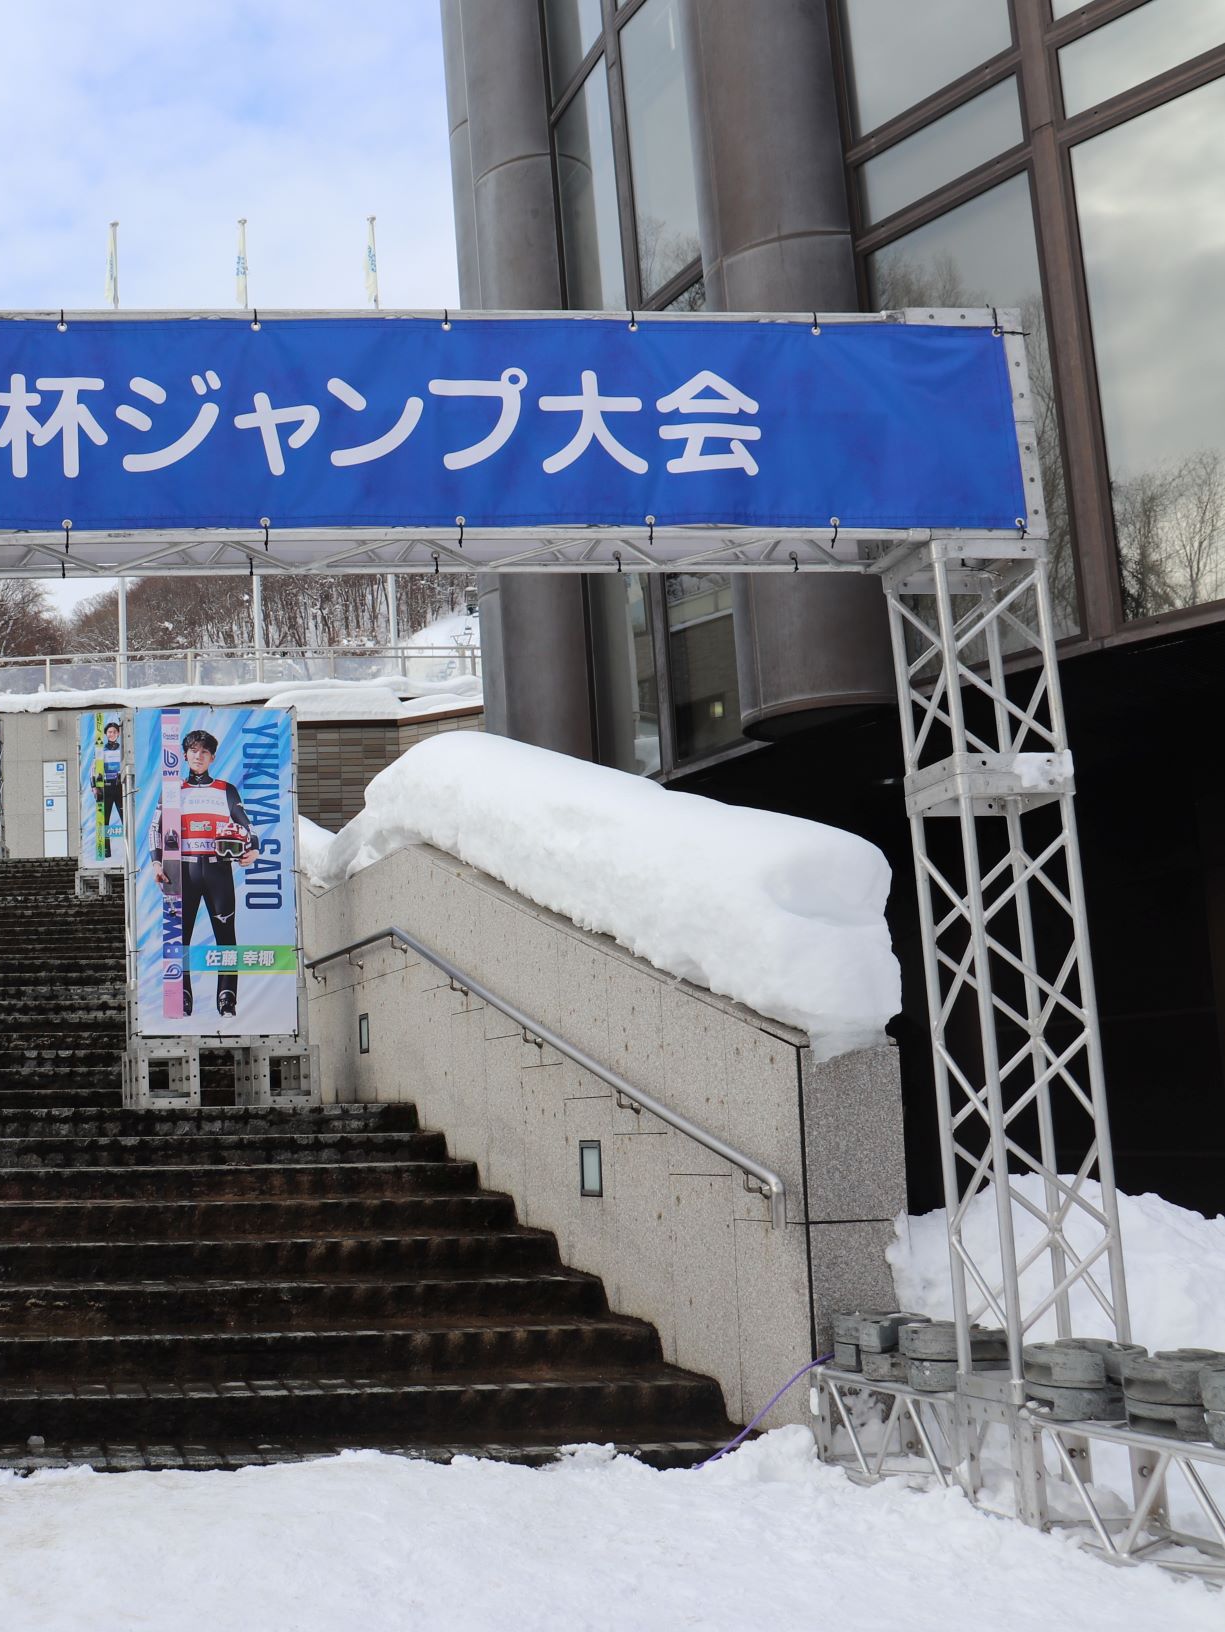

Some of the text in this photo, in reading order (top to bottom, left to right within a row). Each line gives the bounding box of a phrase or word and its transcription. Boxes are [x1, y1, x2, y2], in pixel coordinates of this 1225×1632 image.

[242, 722, 283, 910] YUKIYA SATO
[205, 950, 238, 967] 佐藤
